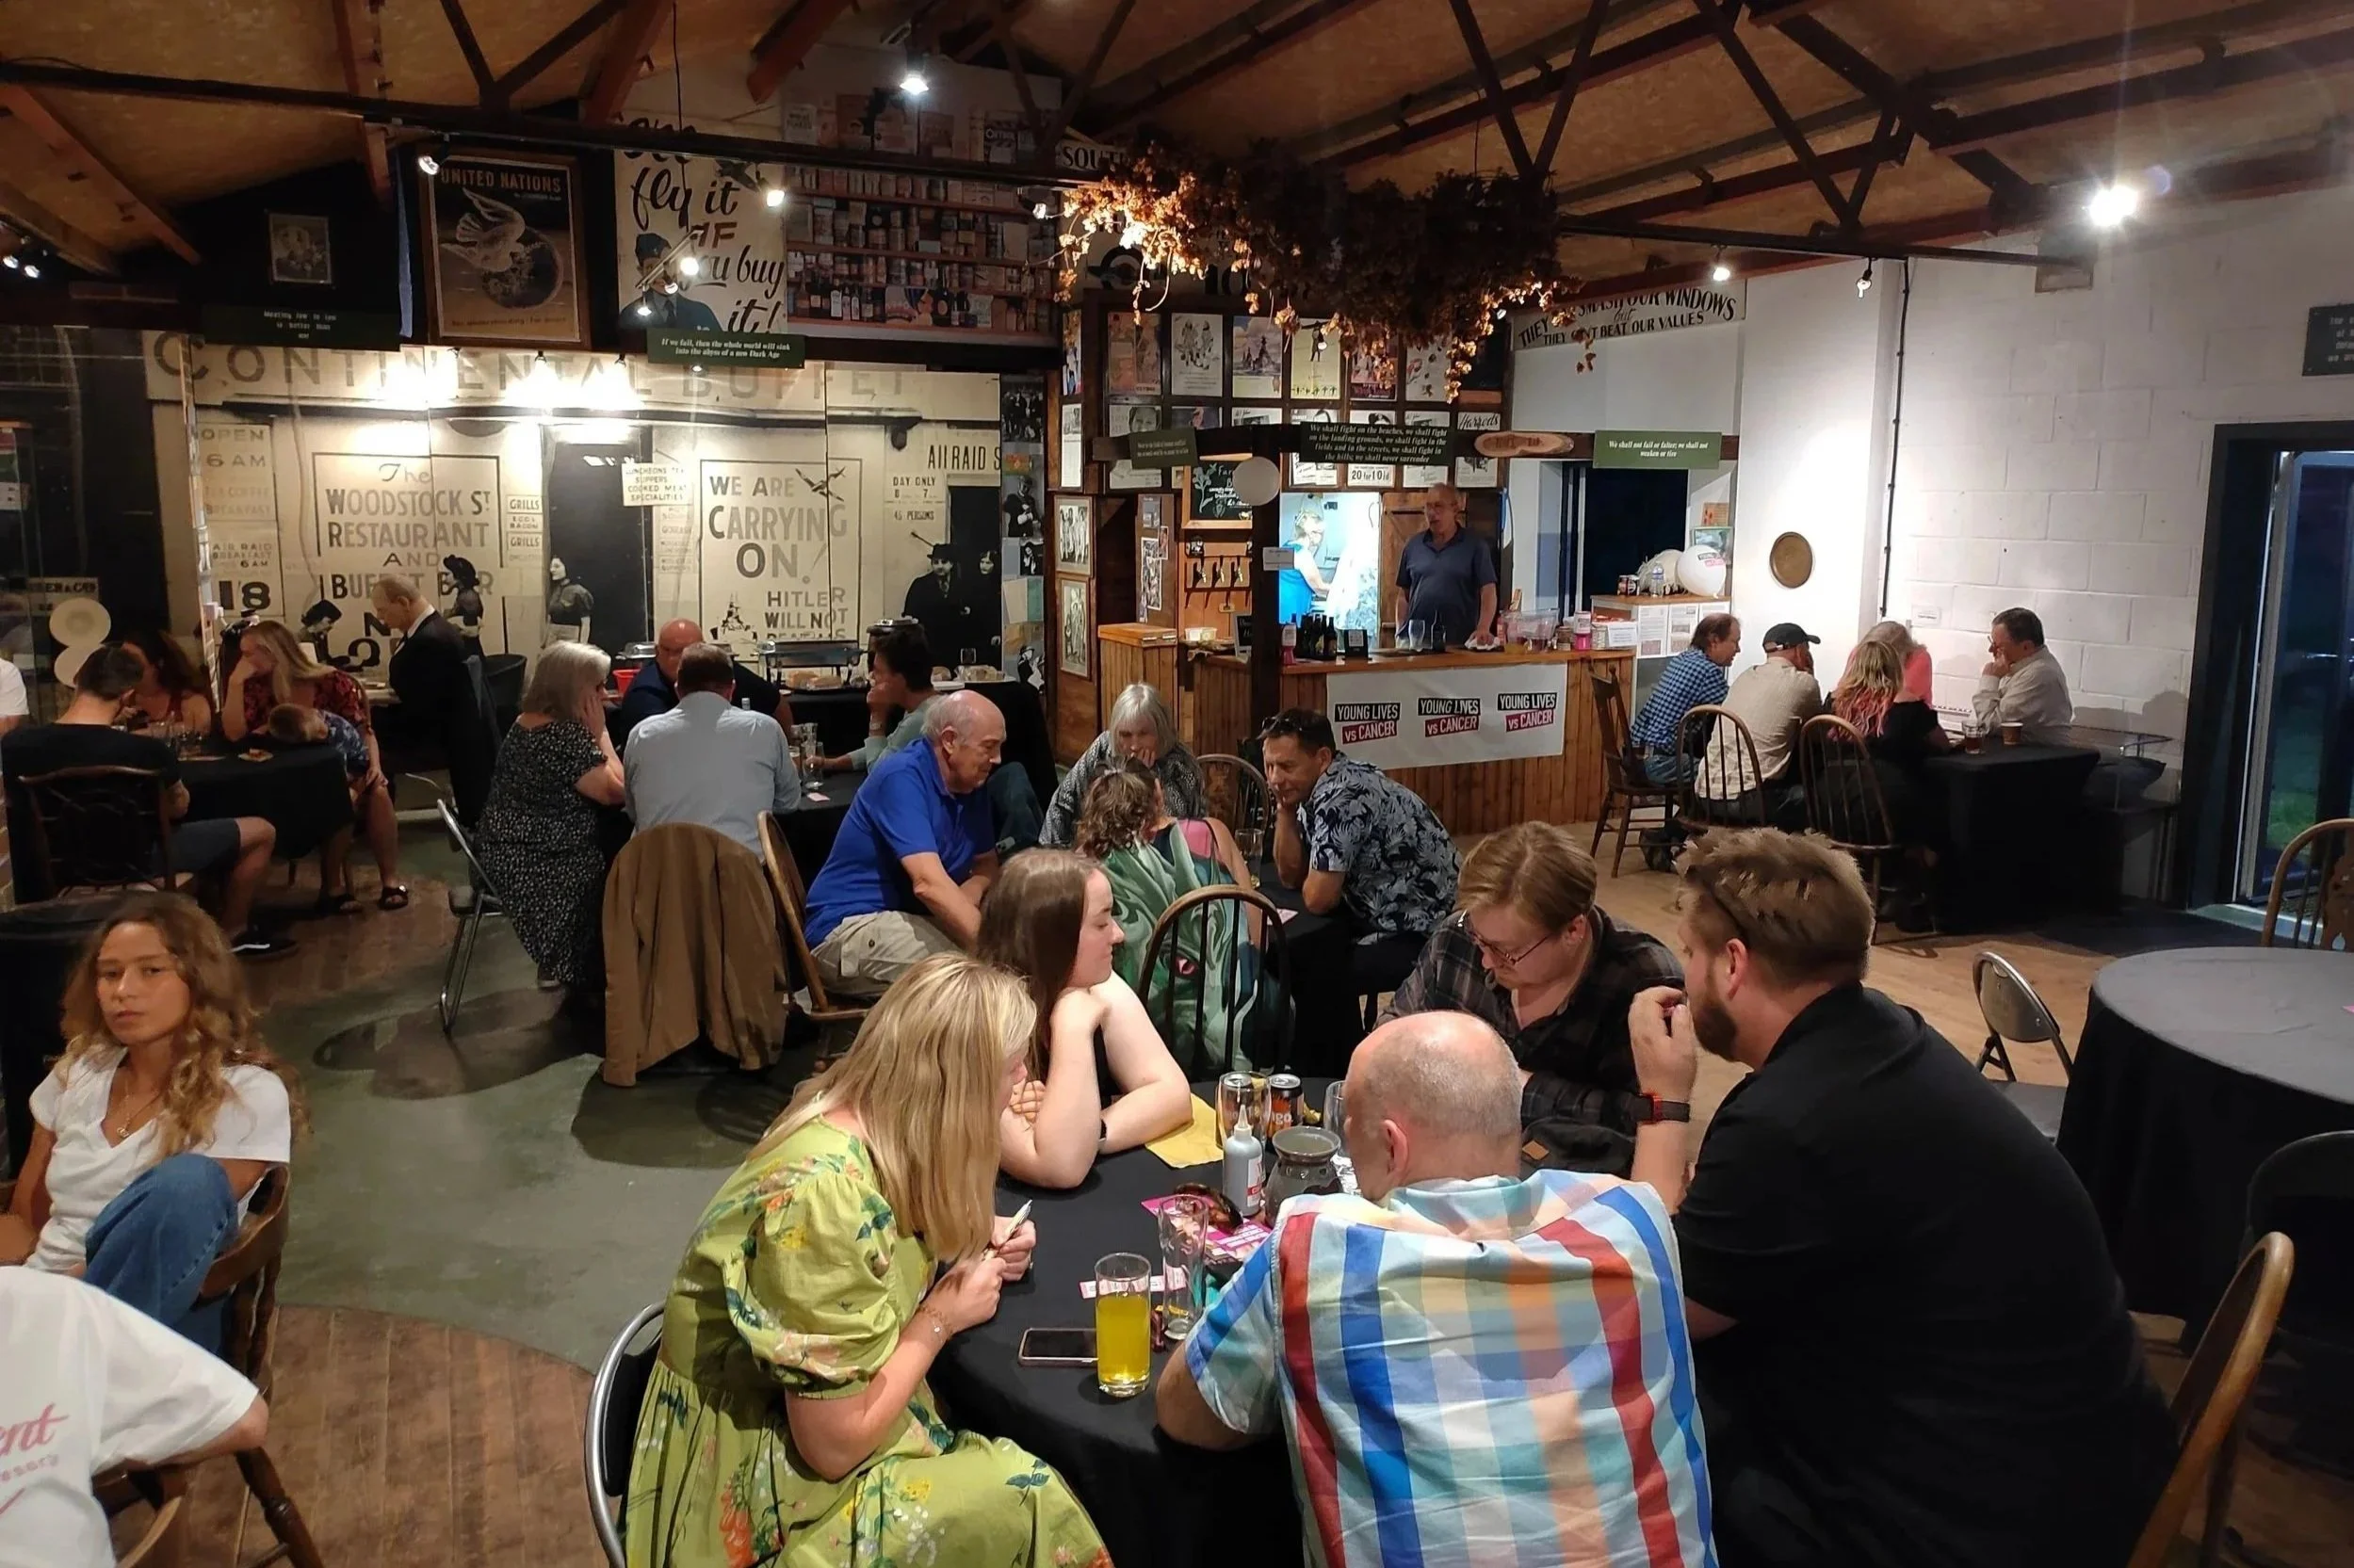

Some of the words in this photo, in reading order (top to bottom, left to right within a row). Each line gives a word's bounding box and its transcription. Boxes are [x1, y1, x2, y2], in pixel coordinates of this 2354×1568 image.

[441, 168, 495, 186] UNITED
[500, 171, 561, 193] NATIONS
[630, 167, 692, 232] fly
[705, 180, 740, 216] it
[737, 244, 785, 299] buy
[728, 299, 783, 334] it!
[1518, 315, 1550, 348] THEY
[1664, 287, 1737, 322] WINDOWS
[1543, 332, 1567, 347] THEY
[1600, 322, 1628, 339] BEAT
[1632, 318, 1655, 333] OUR
[1658, 311, 1704, 331] VALUES
[690, 347, 702, 355] the
[703, 348, 721, 357] abyss
[749, 349, 766, 358] Dark
[768, 350, 781, 359] Age
[1310, 424, 1321, 432] We
[1323, 425, 1339, 433] shall
[1339, 426, 1356, 434] fight
[1367, 426, 1378, 434] the
[1379, 427, 1404, 436] beaches,
[1415, 428, 1431, 436] shall
[1432, 428, 1447, 437] fight
[1459, 413, 1500, 430] Harrods
[202, 428, 264, 443] OPEN
[1331, 435, 1356, 444] landing
[1356, 436, 1384, 445] grounds,
[1395, 436, 1411, 445] shall
[1412, 437, 1427, 446] fight
[1609, 440, 1617, 448] We
[1618, 440, 1632, 448] shall
[1643, 440, 1653, 448] fail
[1685, 441, 1698, 449] shall
[951, 445, 986, 470] RAID
[1315, 443, 1333, 451] fields
[1334, 444, 1347, 452] and
[1419, 447, 1434, 456] fight
[1666, 449, 1677, 458] tire
[206, 453, 224, 467] 6
[232, 454, 266, 468] AM
[379, 462, 432, 484] The
[893, 477, 910, 487] DAY
[916, 477, 935, 487] ONLY
[1352, 470, 1363, 480] 20
[1363, 471, 1372, 481] for
[709, 476, 742, 495] WE
[752, 477, 794, 497] ARE
[326, 489, 464, 517] WOODSTOCK
[510, 498, 540, 509] GRILLS
[708, 504, 847, 542] CARRYING
[907, 510, 934, 521] PERSONS
[328, 522, 490, 548] RESTAURANT
[511, 537, 540, 547] GRILLS
[382, 552, 441, 567] AND
[737, 542, 828, 585] ON!
[438, 572, 495, 599] BR
[767, 586, 847, 607] HITLER
[765, 612, 806, 630] WILL
[810, 607, 848, 630] NOT
[1421, 699, 1453, 715] YOUNG
[1454, 700, 1479, 715] LIVES
[1500, 694, 1530, 709] YOUNG
[1532, 693, 1556, 708] LIVES
[1337, 705, 1370, 720] YOUNG
[1372, 703, 1398, 719] LIVES
[1507, 718, 1518, 729] vs
[1520, 710, 1552, 727] CANCER
[1345, 730, 1356, 743] vs
[1359, 721, 1396, 740] CANCER
[1427, 723, 1438, 735] vs
[1439, 716, 1477, 734] CANCER
